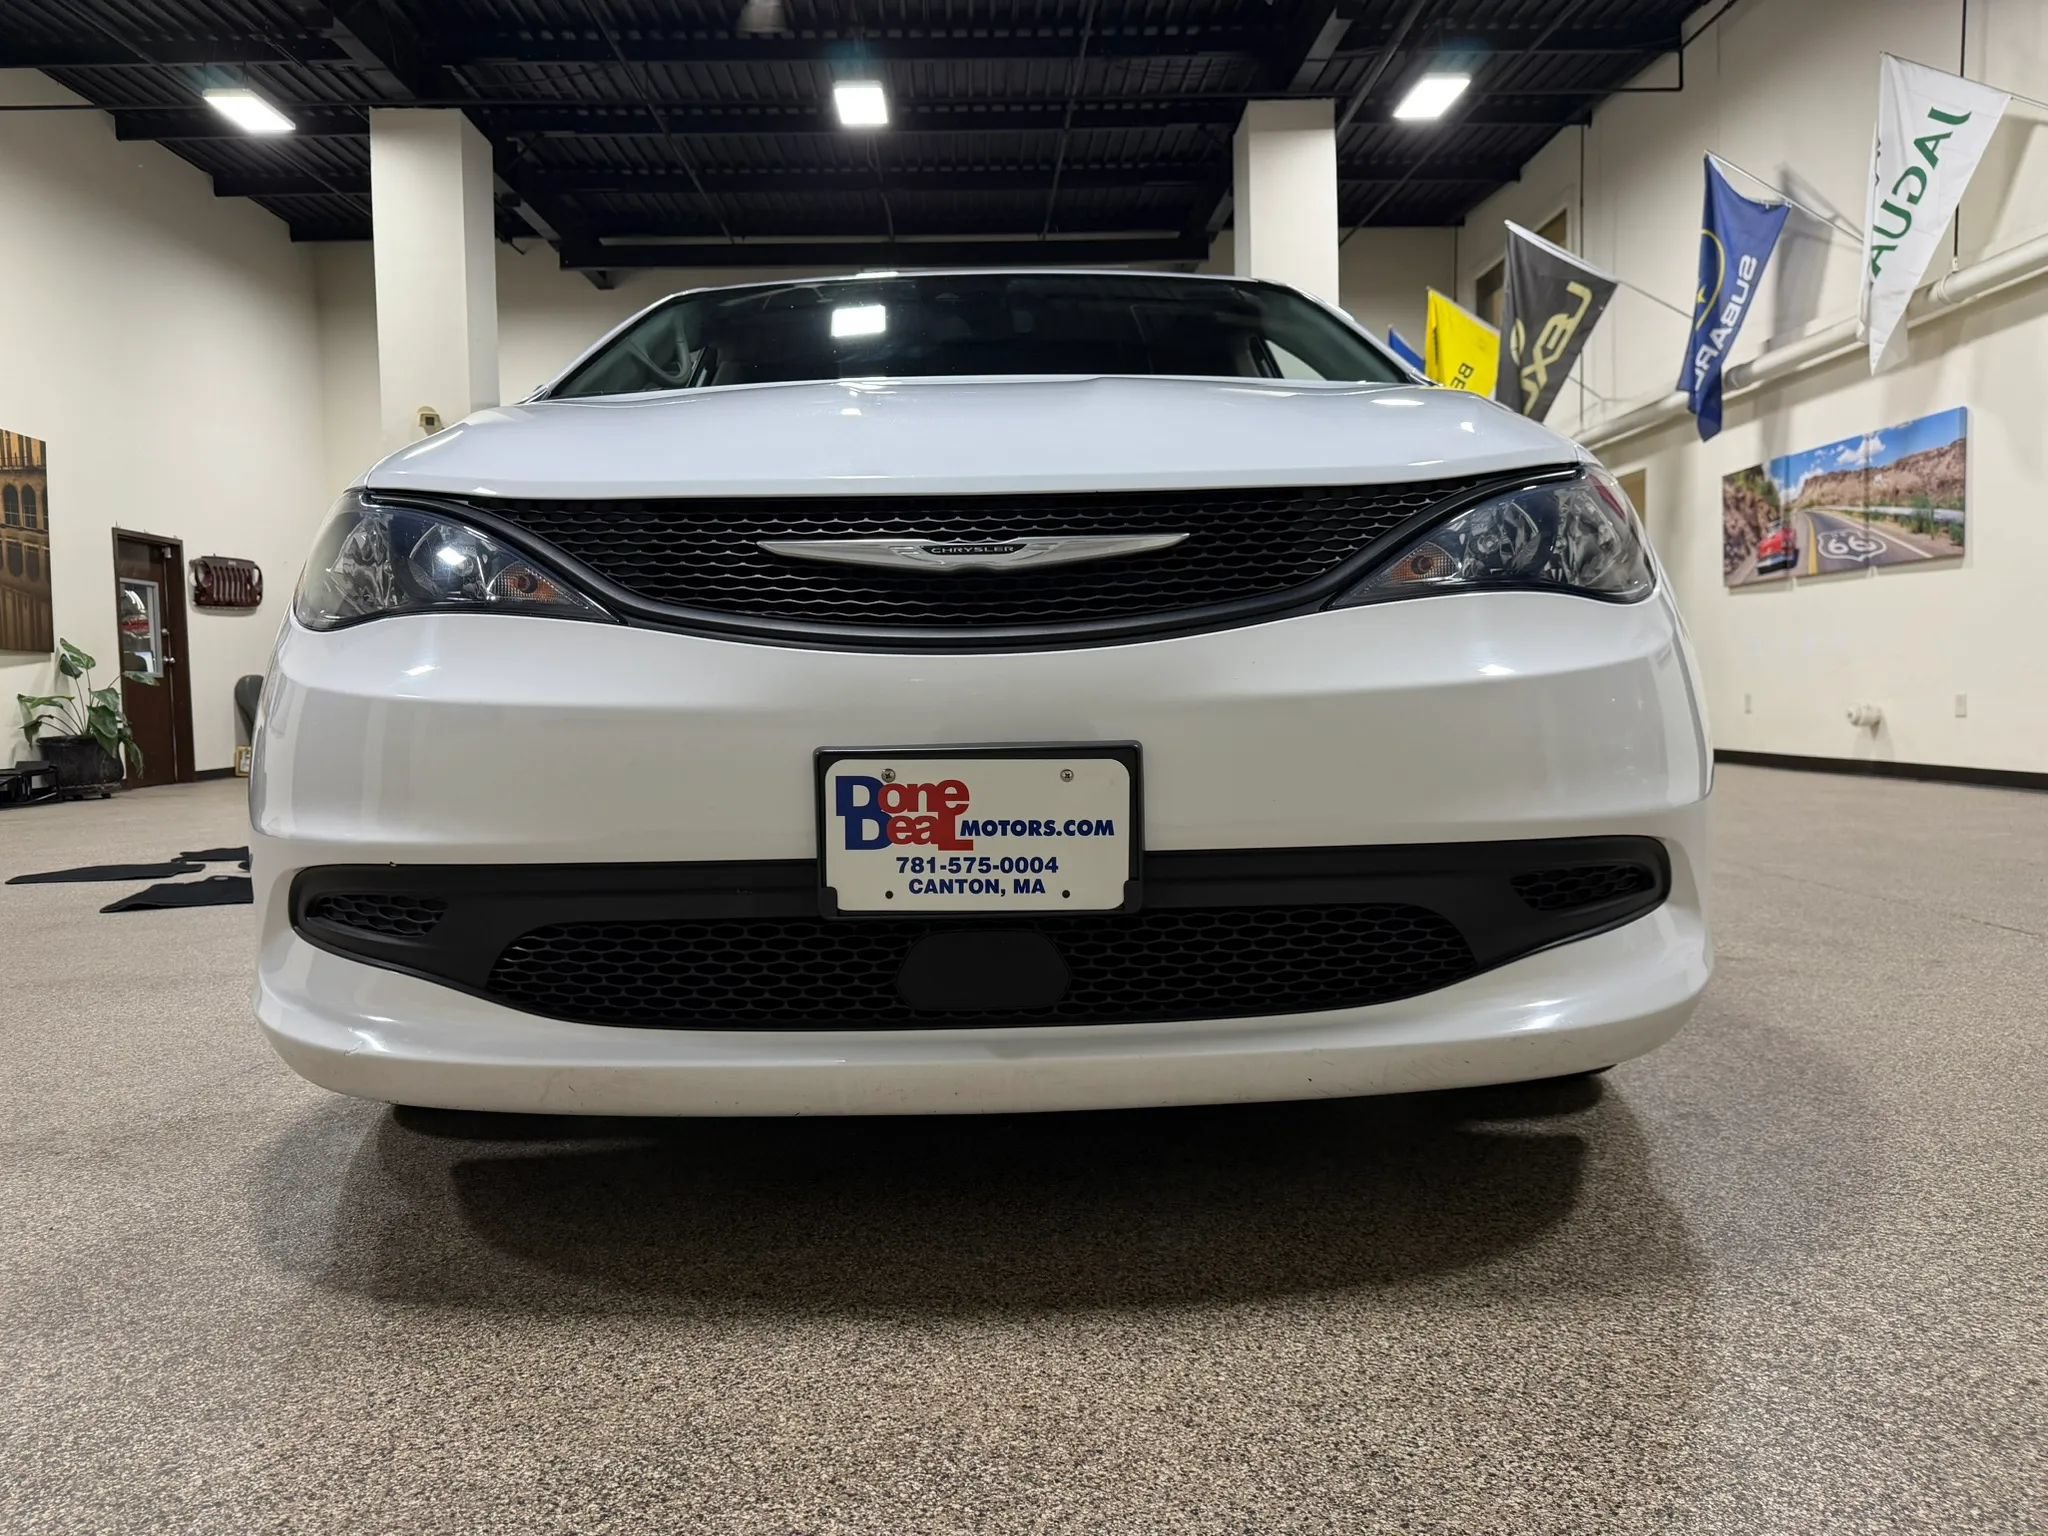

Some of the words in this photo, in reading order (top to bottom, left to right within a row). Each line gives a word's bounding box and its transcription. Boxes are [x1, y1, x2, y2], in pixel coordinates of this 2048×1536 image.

[1828, 536, 1877, 554] 66
[835, 775, 970, 816] Done
[959, 819, 1115, 837] MOTORS.COM
[896, 856, 1059, 874] 781-575-0004
[908, 878, 1006, 897] CANTON,
[1013, 879, 1046, 894] MA
